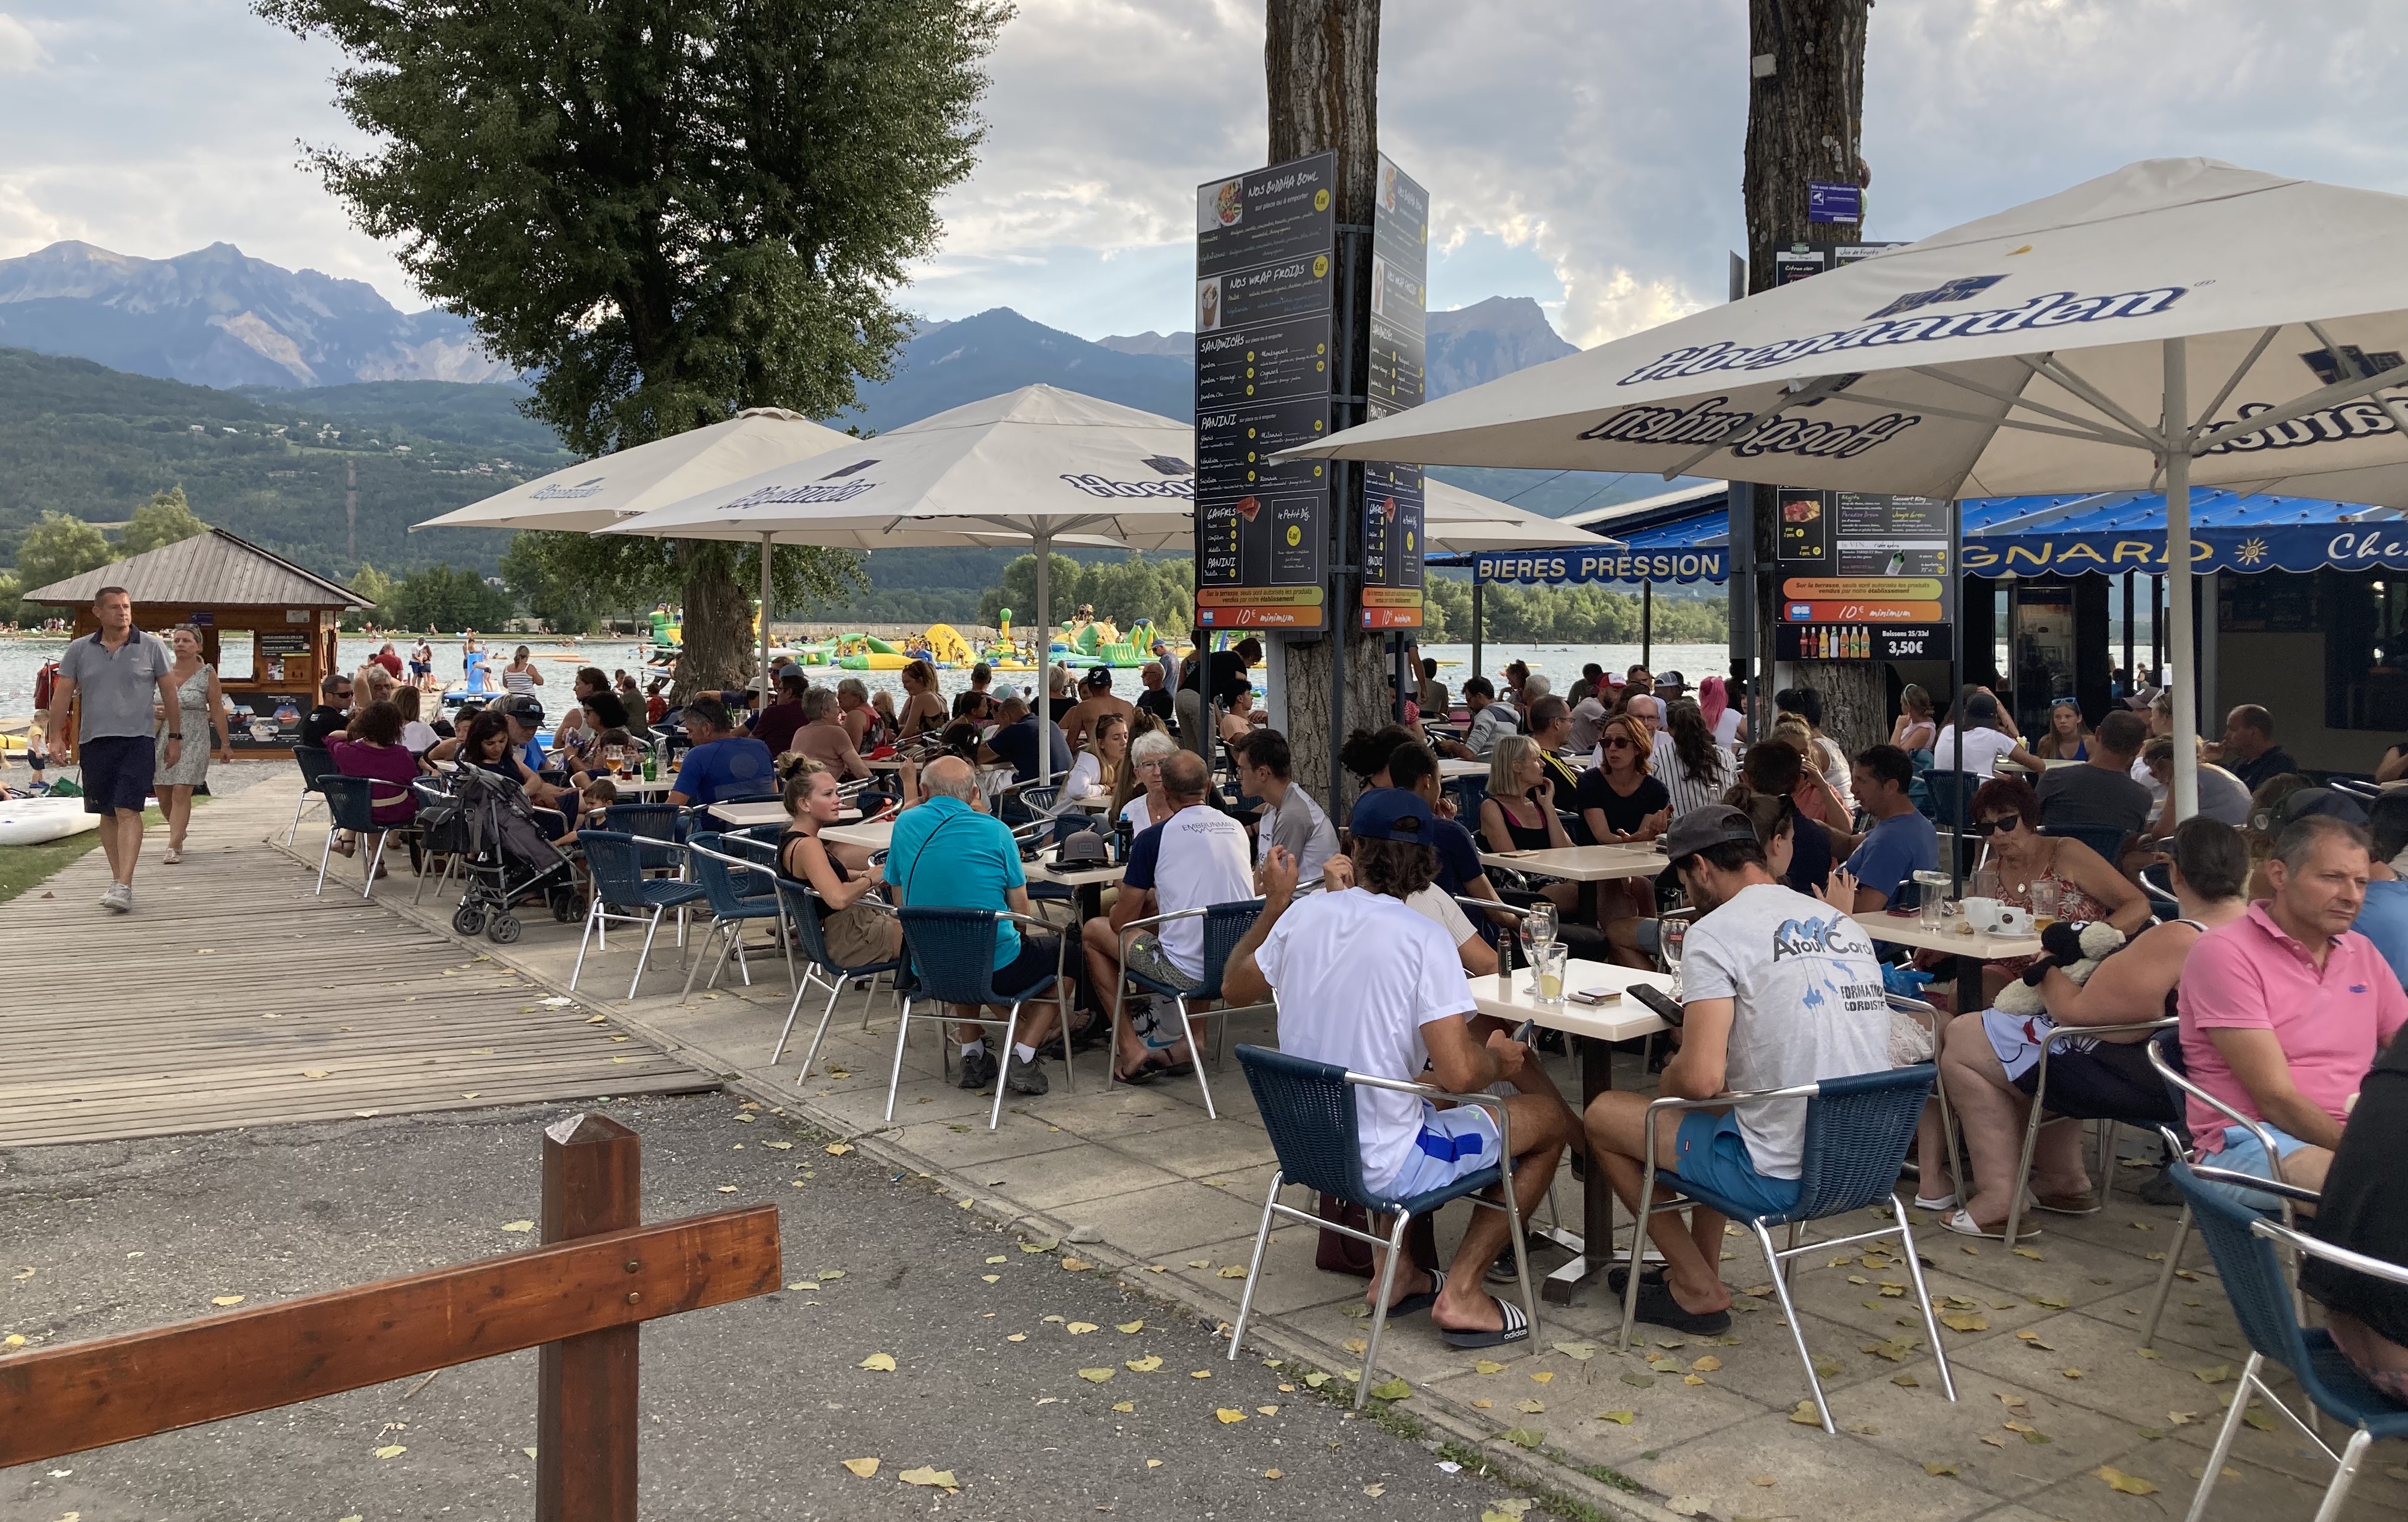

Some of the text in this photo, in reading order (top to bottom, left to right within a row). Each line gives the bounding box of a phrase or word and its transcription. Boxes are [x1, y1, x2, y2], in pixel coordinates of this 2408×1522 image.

[1248, 184, 1265, 197] NOS
[1297, 170, 1320, 186] BOWL
[1287, 192, 1308, 203] emporter
[1230, 277, 1247, 289] NOS
[1249, 269, 1272, 285] WRAP
[1273, 264, 1305, 282] FROIDS
[1616, 284, 2189, 385] Hoegaarden
[1201, 333, 1245, 353] SANDWICHS
[1201, 414, 1237, 430] PANINI
[1283, 508, 1300, 519] Petit
[2328, 531, 2408, 559] Che
[1207, 557, 1237, 569] PANINI
[1479, 553, 1719, 577] BIERES PRESSION
[1236, 608, 1294, 625] 10€ minimum
[1839, 605, 1864, 619] 10€
[1869, 609, 1911, 617] minimum
[1889, 641, 1924, 656] 3,50€
[1182, 822, 1235, 832] EMBRUNMAN
[1773, 934, 1825, 963] Atout
[1504, 1329, 1527, 1340] adidas
